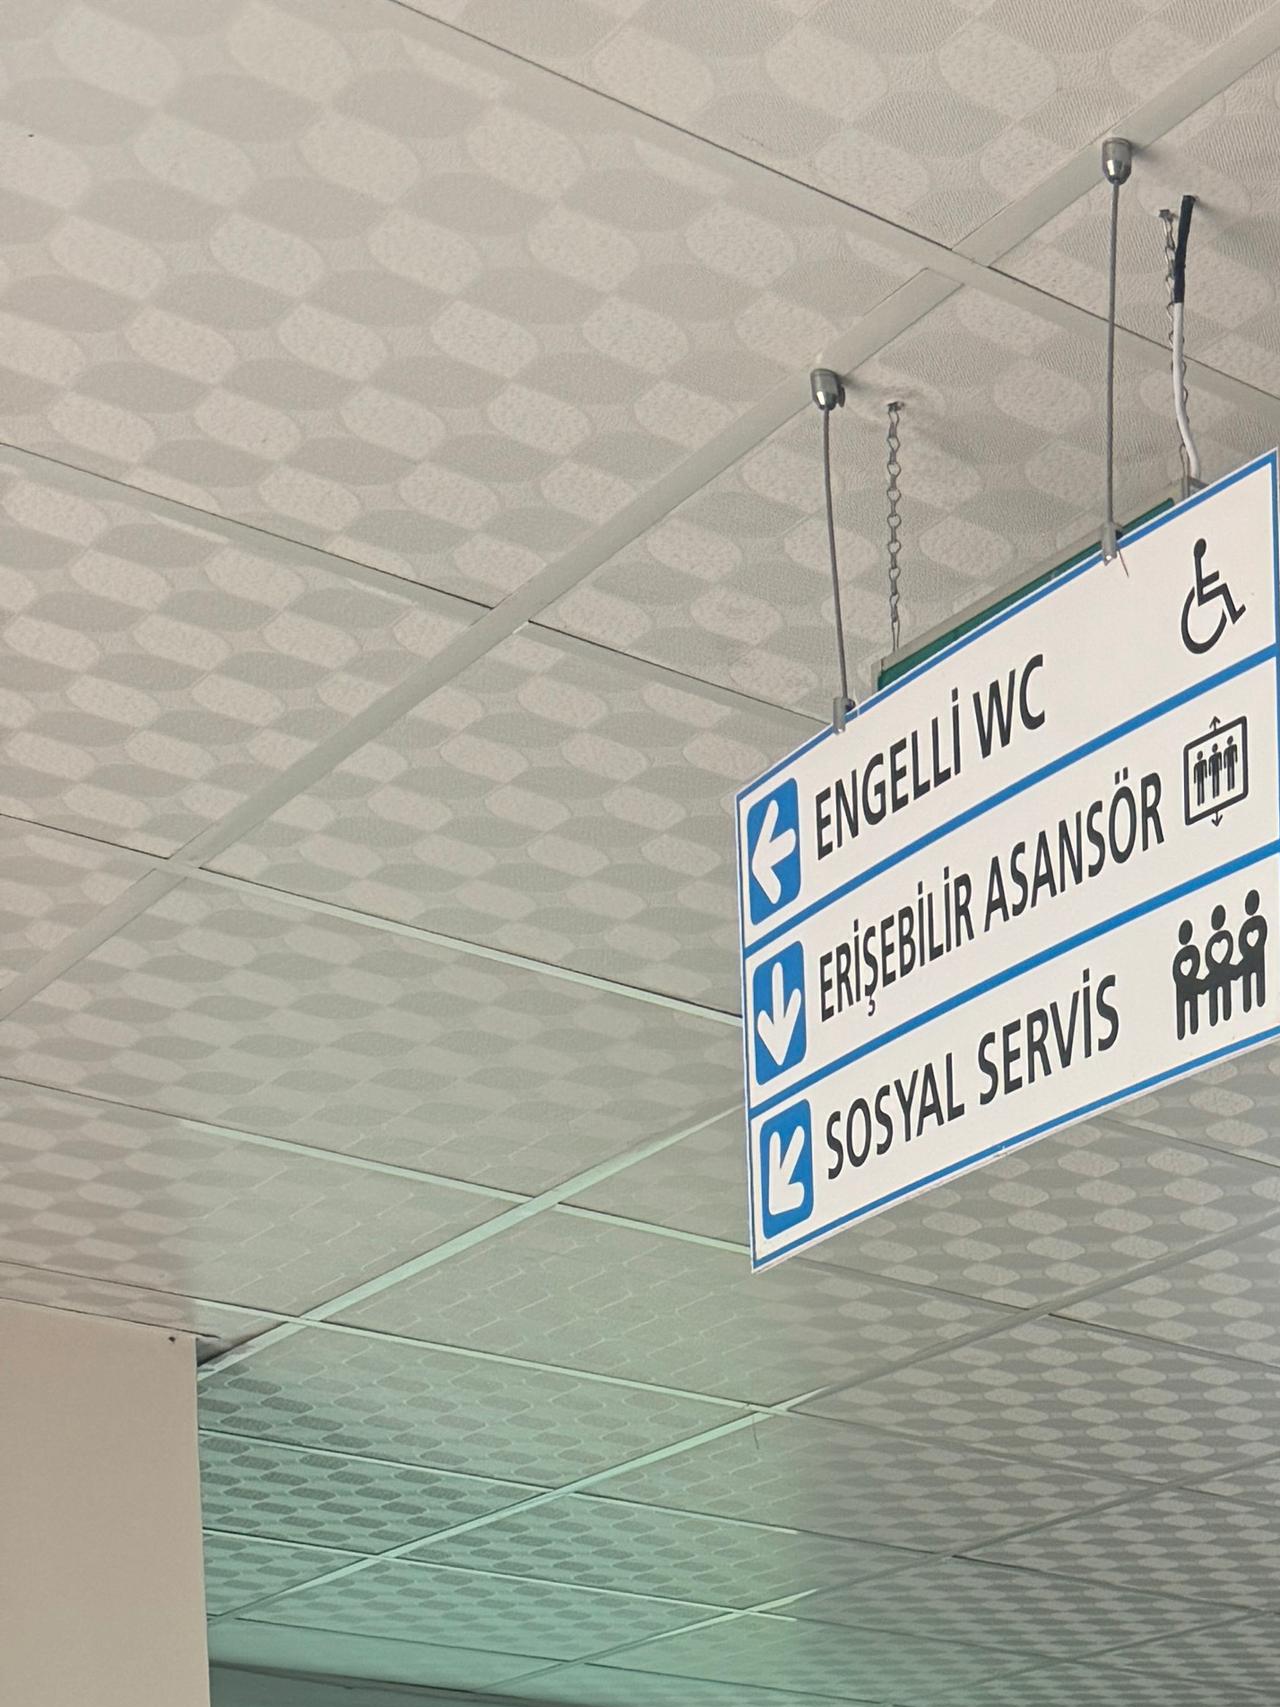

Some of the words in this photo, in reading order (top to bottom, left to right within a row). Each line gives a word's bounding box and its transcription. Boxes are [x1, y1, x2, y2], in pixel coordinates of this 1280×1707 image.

[814, 685, 962, 861] ENGELLİ
[973, 653, 1047, 759] WC
[819, 861, 974, 1026] ERİŞEBİLİR
[984, 767, 1166, 933] ASANSÖR
[826, 1052, 965, 1181] SOSYAL
[978, 968, 1121, 1107] SERVİS
